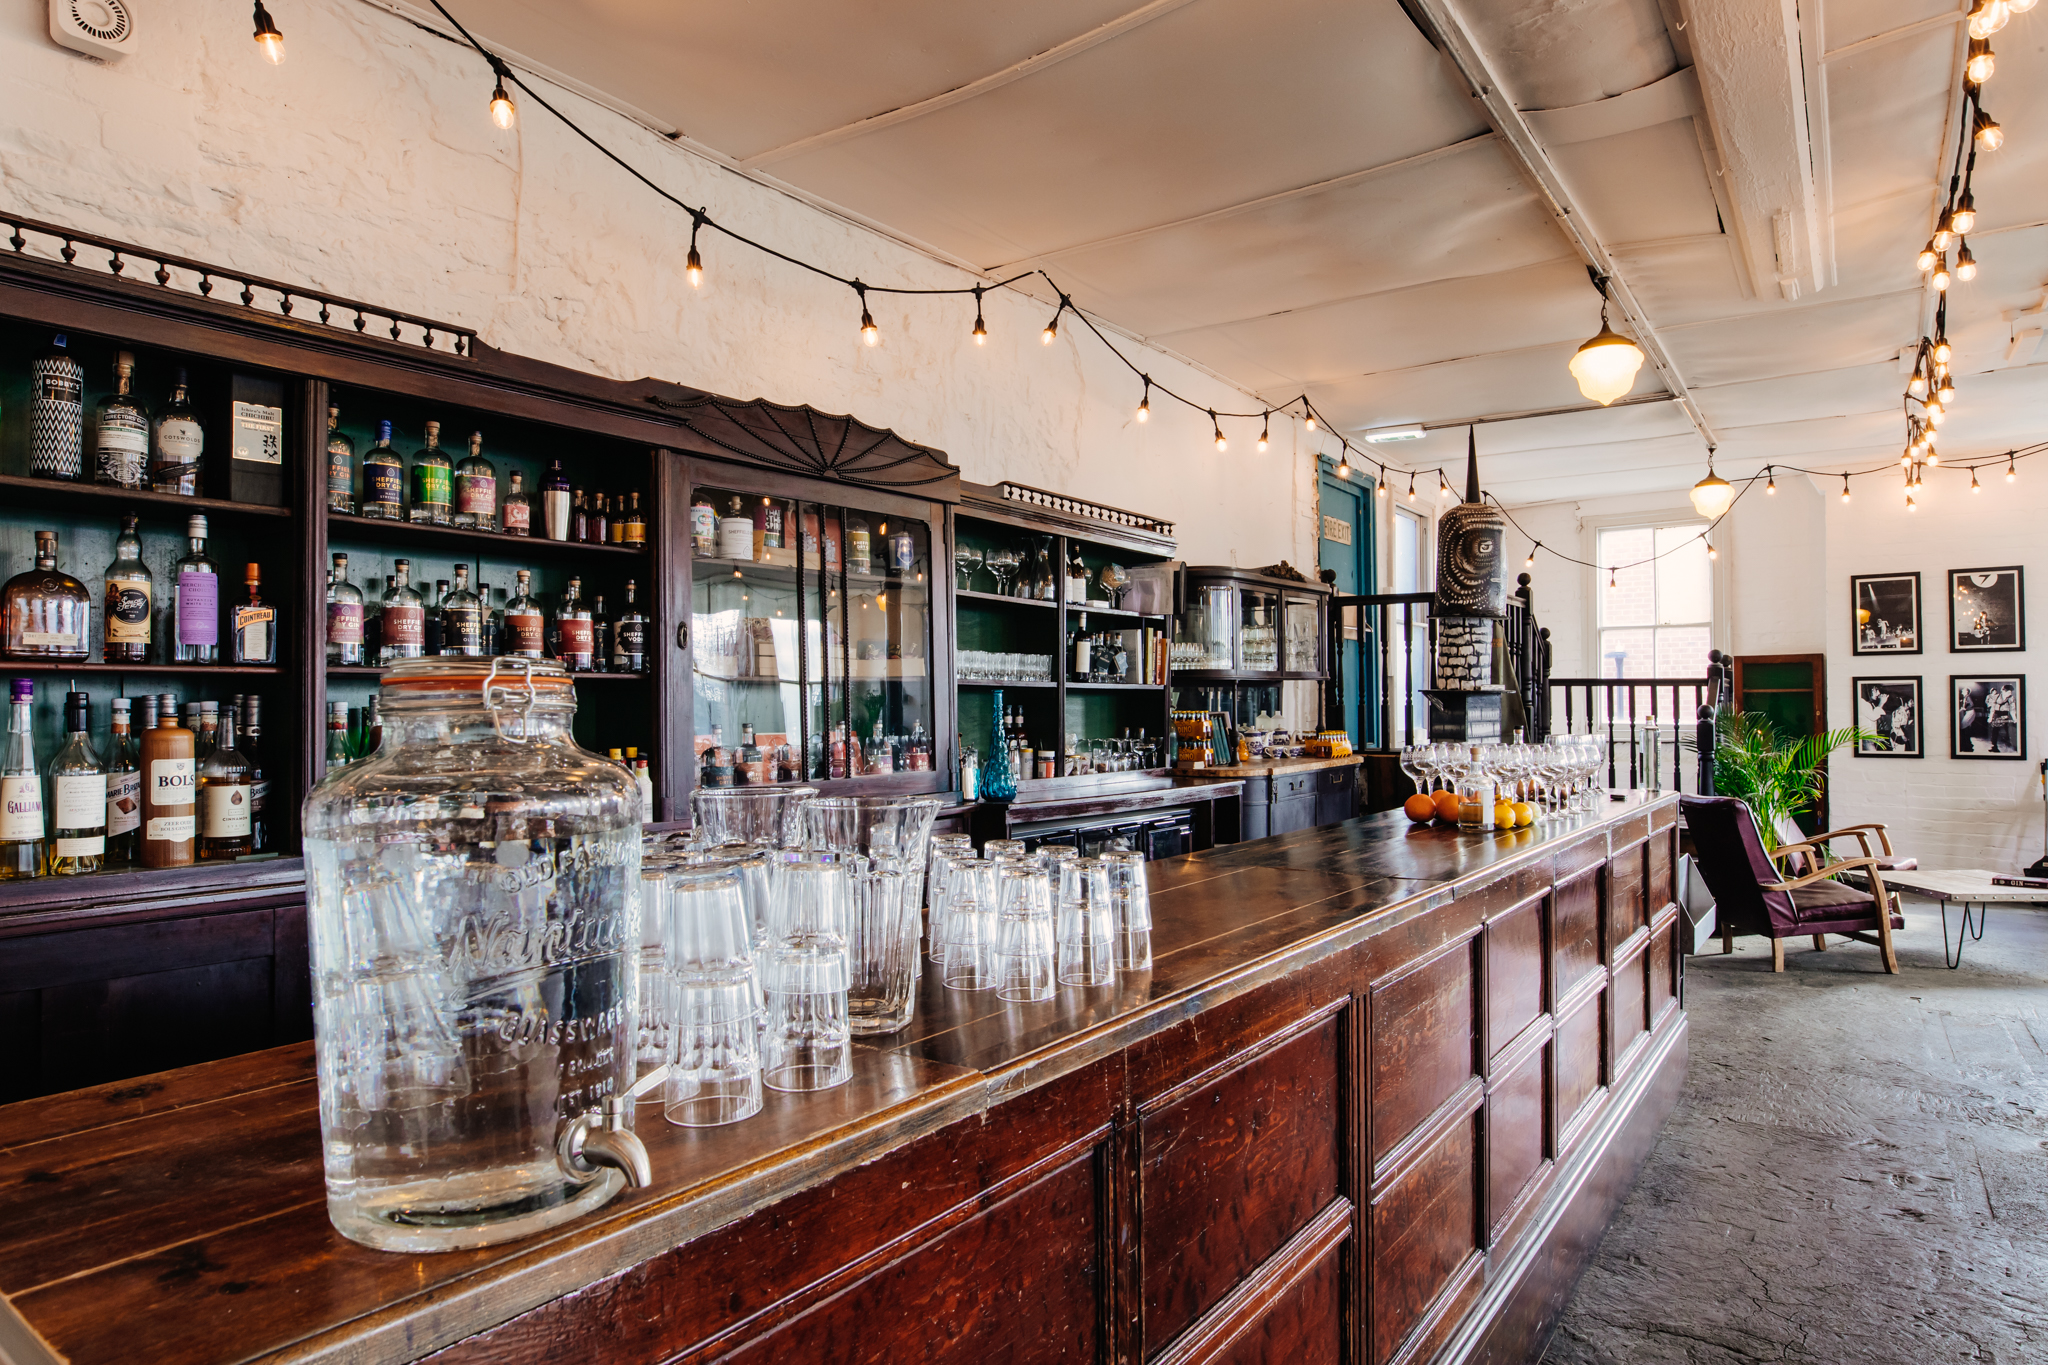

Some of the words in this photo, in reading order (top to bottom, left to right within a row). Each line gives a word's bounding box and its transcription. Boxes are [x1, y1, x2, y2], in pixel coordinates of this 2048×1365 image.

[45, 378, 80, 390] BOBBY'S
[164, 434, 201, 443] COTSWOLDS
[1337, 522, 1350, 542] EXIT
[240, 611, 271, 626] COINTREAU
[158, 774, 195, 788] BOLS
[8, 800, 42, 814] GALLIAN
